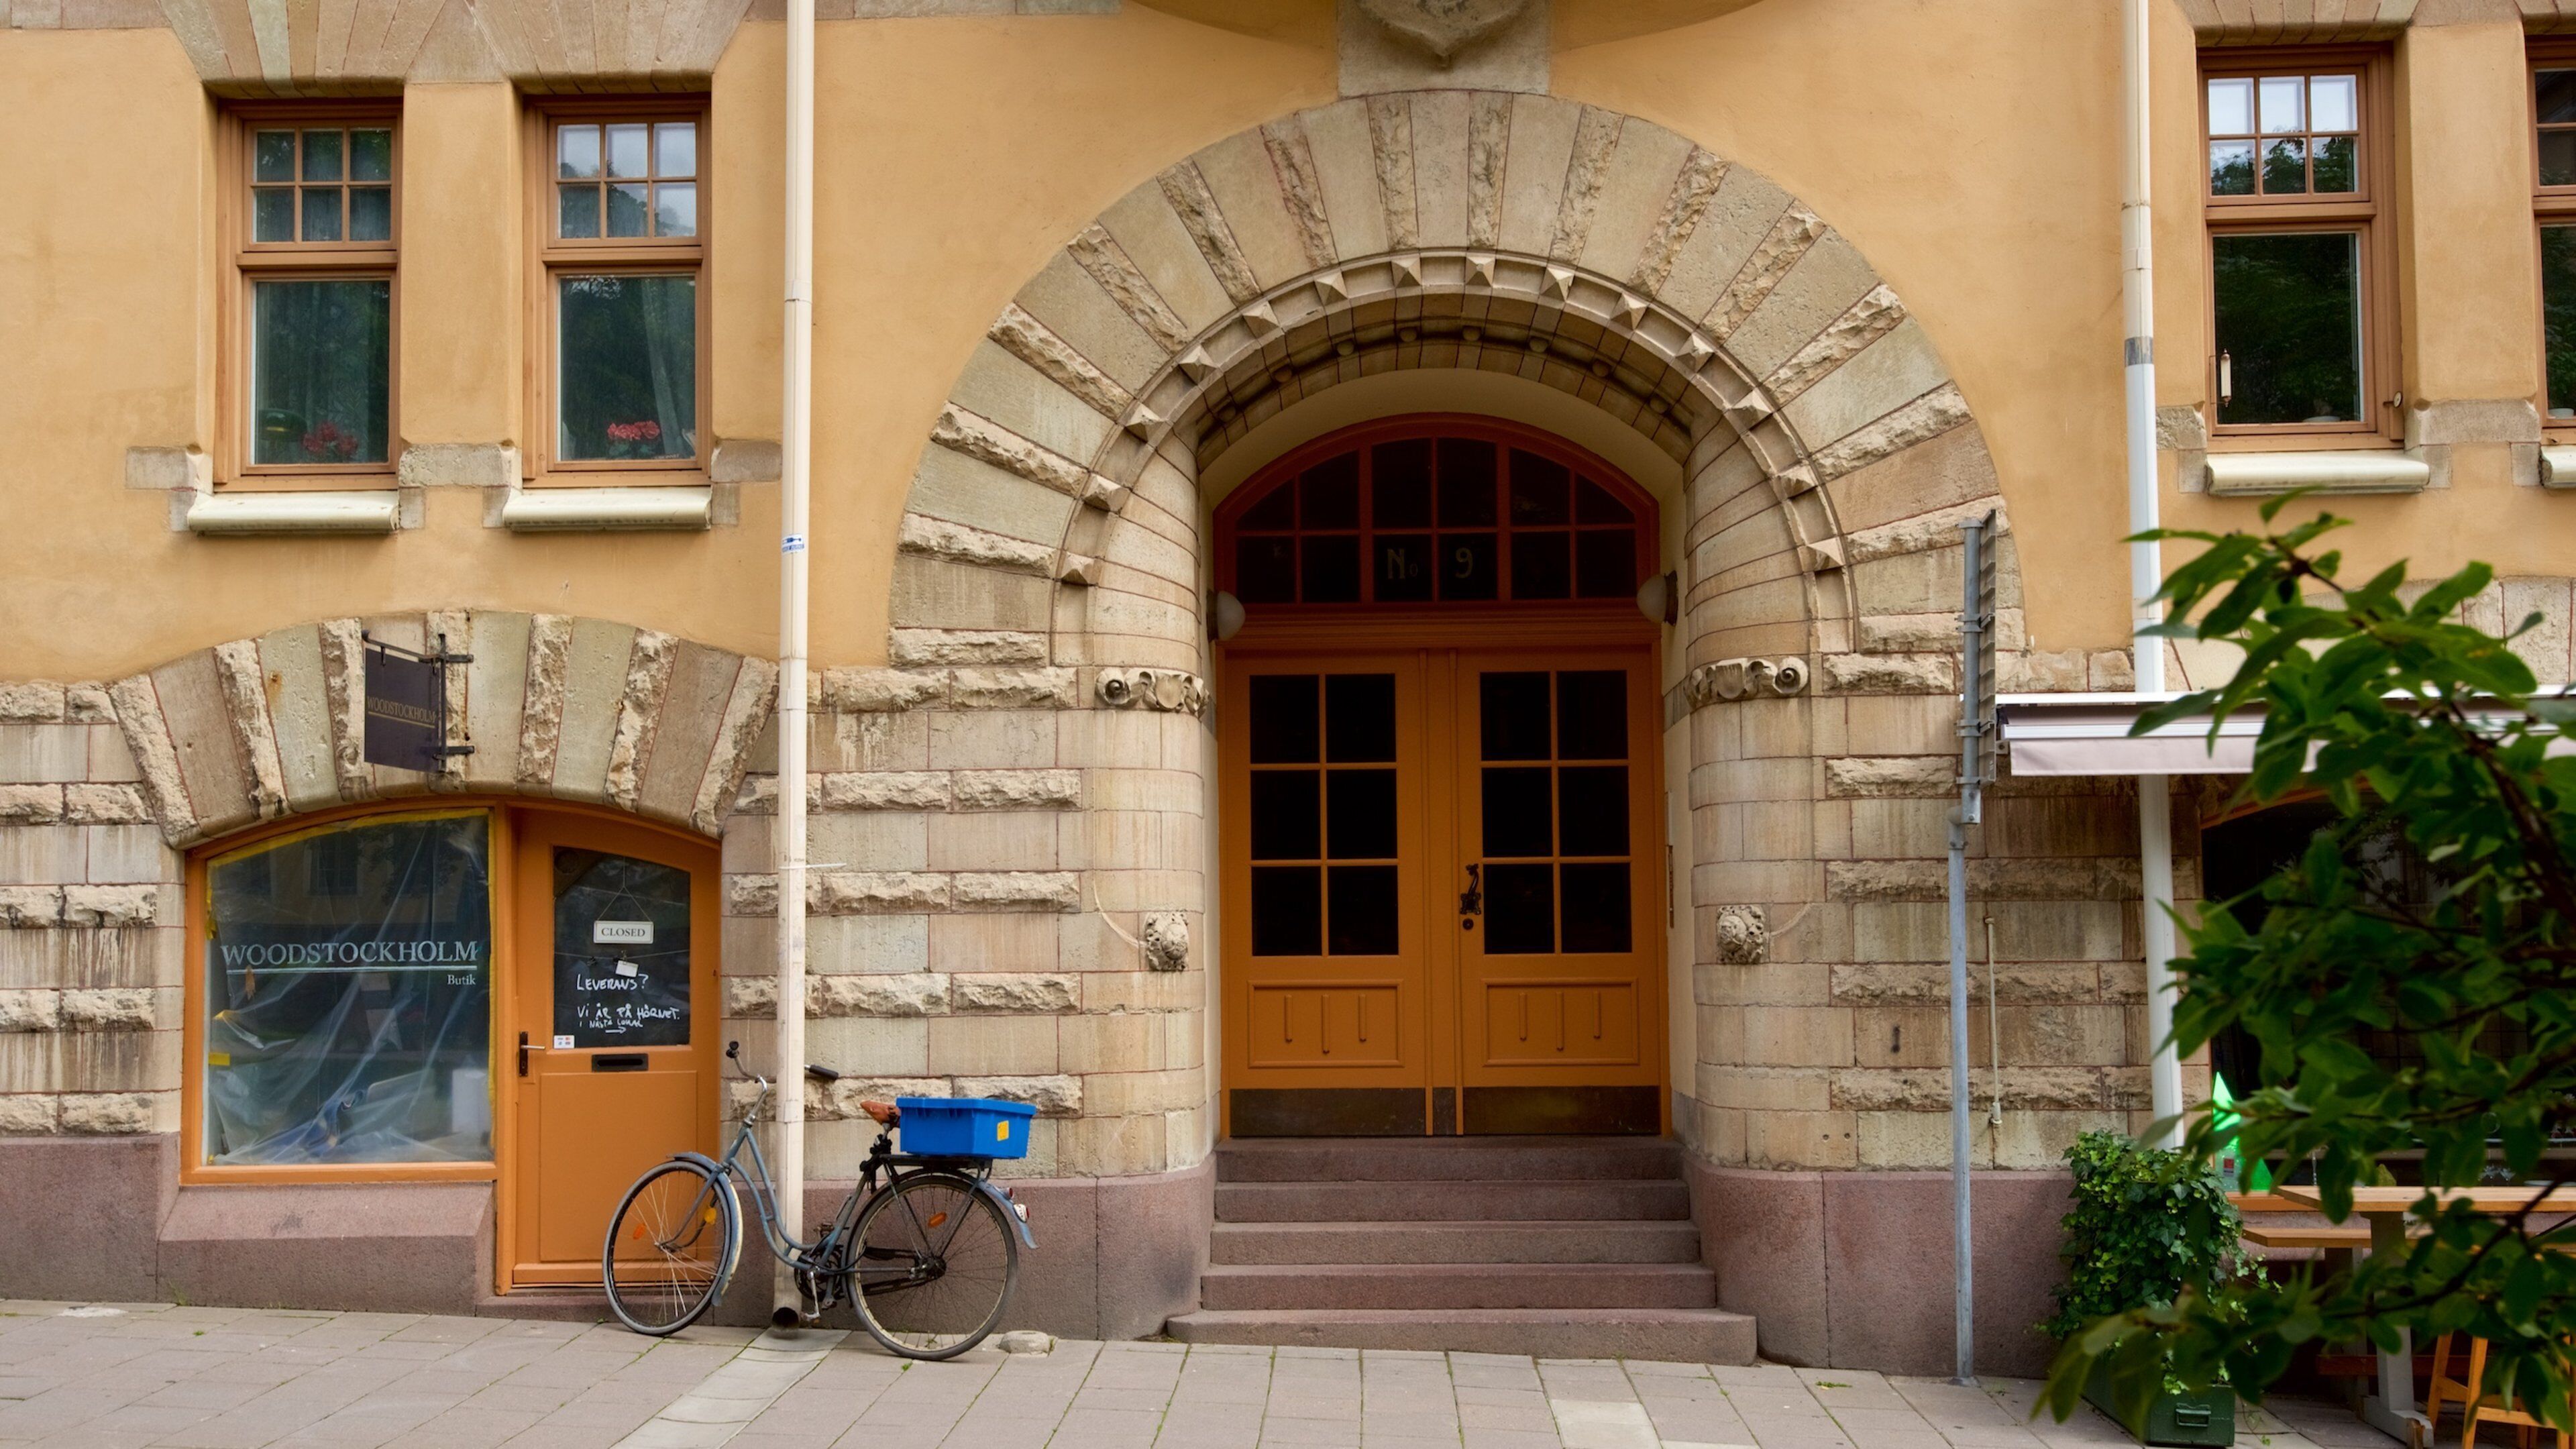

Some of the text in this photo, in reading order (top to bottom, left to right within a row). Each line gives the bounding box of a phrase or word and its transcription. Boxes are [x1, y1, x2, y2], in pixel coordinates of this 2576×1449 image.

[1455, 547, 1474, 579] 9
[367, 696, 436, 724] WOODSTOCKHOLM
[601, 927, 645, 937] CLOSED
[221, 940, 478, 967] WOODSTOCKHOLM
[447, 974, 476, 985] Butik
[616, 1003, 633, 1019] PÅ
